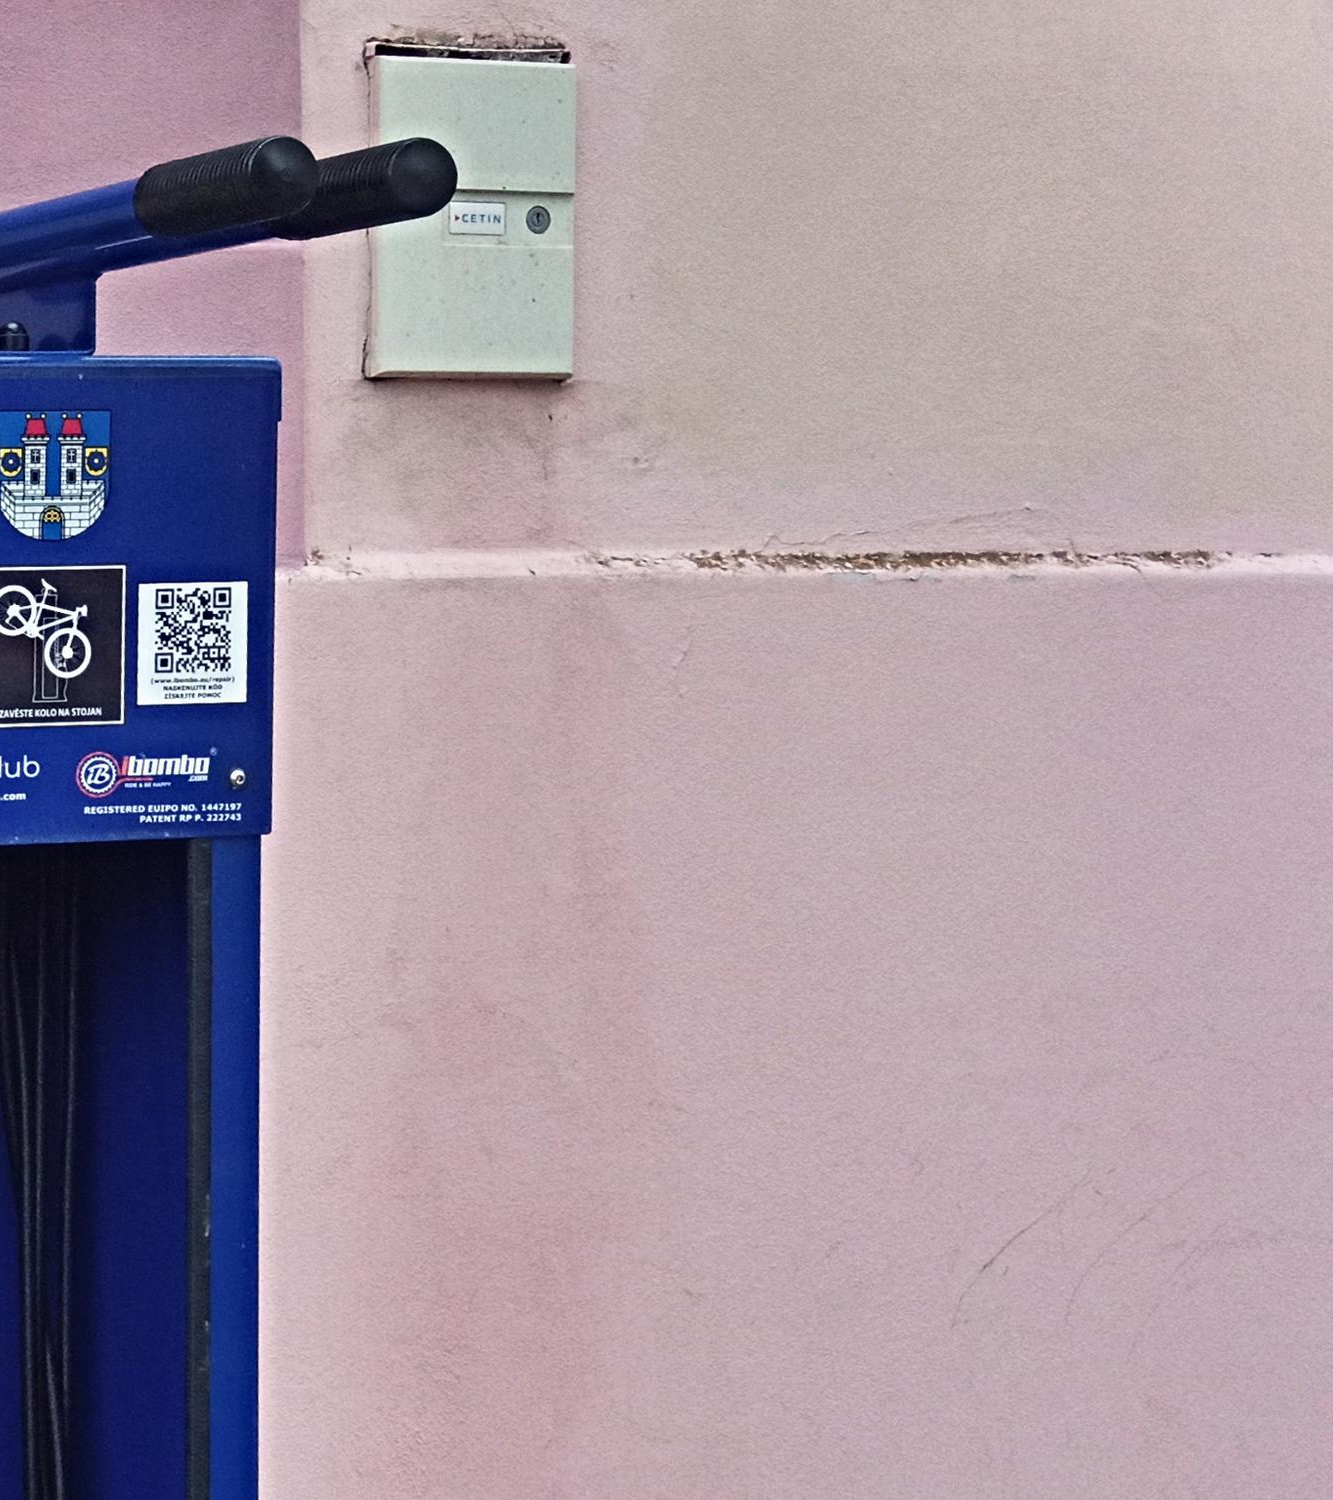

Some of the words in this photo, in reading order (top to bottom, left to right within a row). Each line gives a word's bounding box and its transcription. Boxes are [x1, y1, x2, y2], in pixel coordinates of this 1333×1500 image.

[461, 213, 502, 224] CETIN
[35, 708, 57, 717] KOLO
[58, 708, 70, 717] NA
[72, 707, 102, 717] STOJAN
[84, 805, 145, 814] REGISTERED
[148, 804, 178, 813] EUIPO
[181, 804, 198, 812] NO.
[201, 803, 242, 811] 1447197
[140, 814, 177, 823] PATENT
[179, 814, 193, 822] RP
[194, 814, 204, 822] P.
[206, 813, 242, 822] 222743
